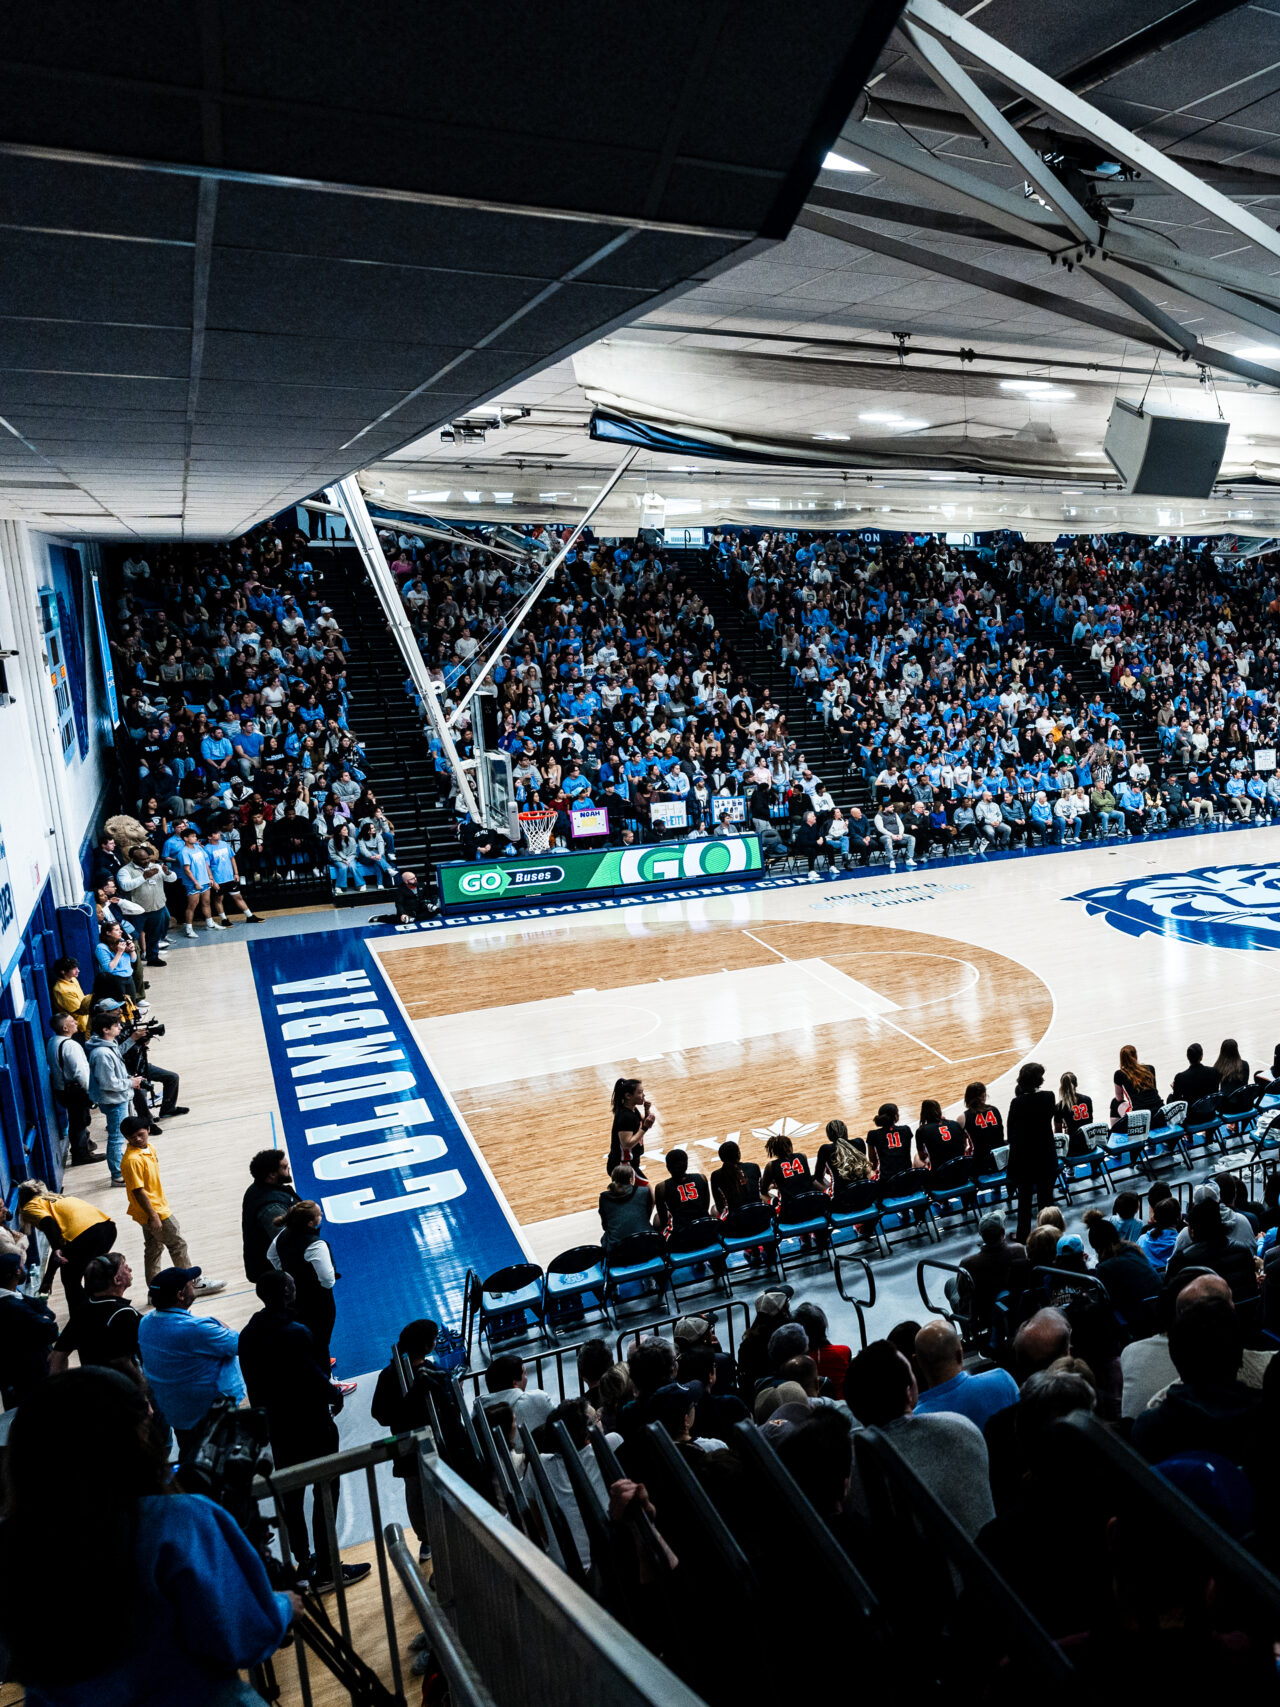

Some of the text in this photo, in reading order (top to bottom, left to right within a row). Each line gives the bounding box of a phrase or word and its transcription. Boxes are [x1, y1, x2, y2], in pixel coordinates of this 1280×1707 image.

[619, 838, 747, 885] GO
[461, 869, 552, 892] GO Buses
[394, 873, 825, 932] GOCOLUMBIALIONS.COM
[871, 895, 936, 908] COURT
[272, 969, 467, 1224] COLUMBIA
[975, 1109, 998, 1129] 44
[1071, 1103, 1089, 1121] 32
[888, 1131, 902, 1149] 11
[939, 1125, 951, 1142] 5
[782, 1157, 804, 1178] 24
[677, 1182, 699, 1202] 15
